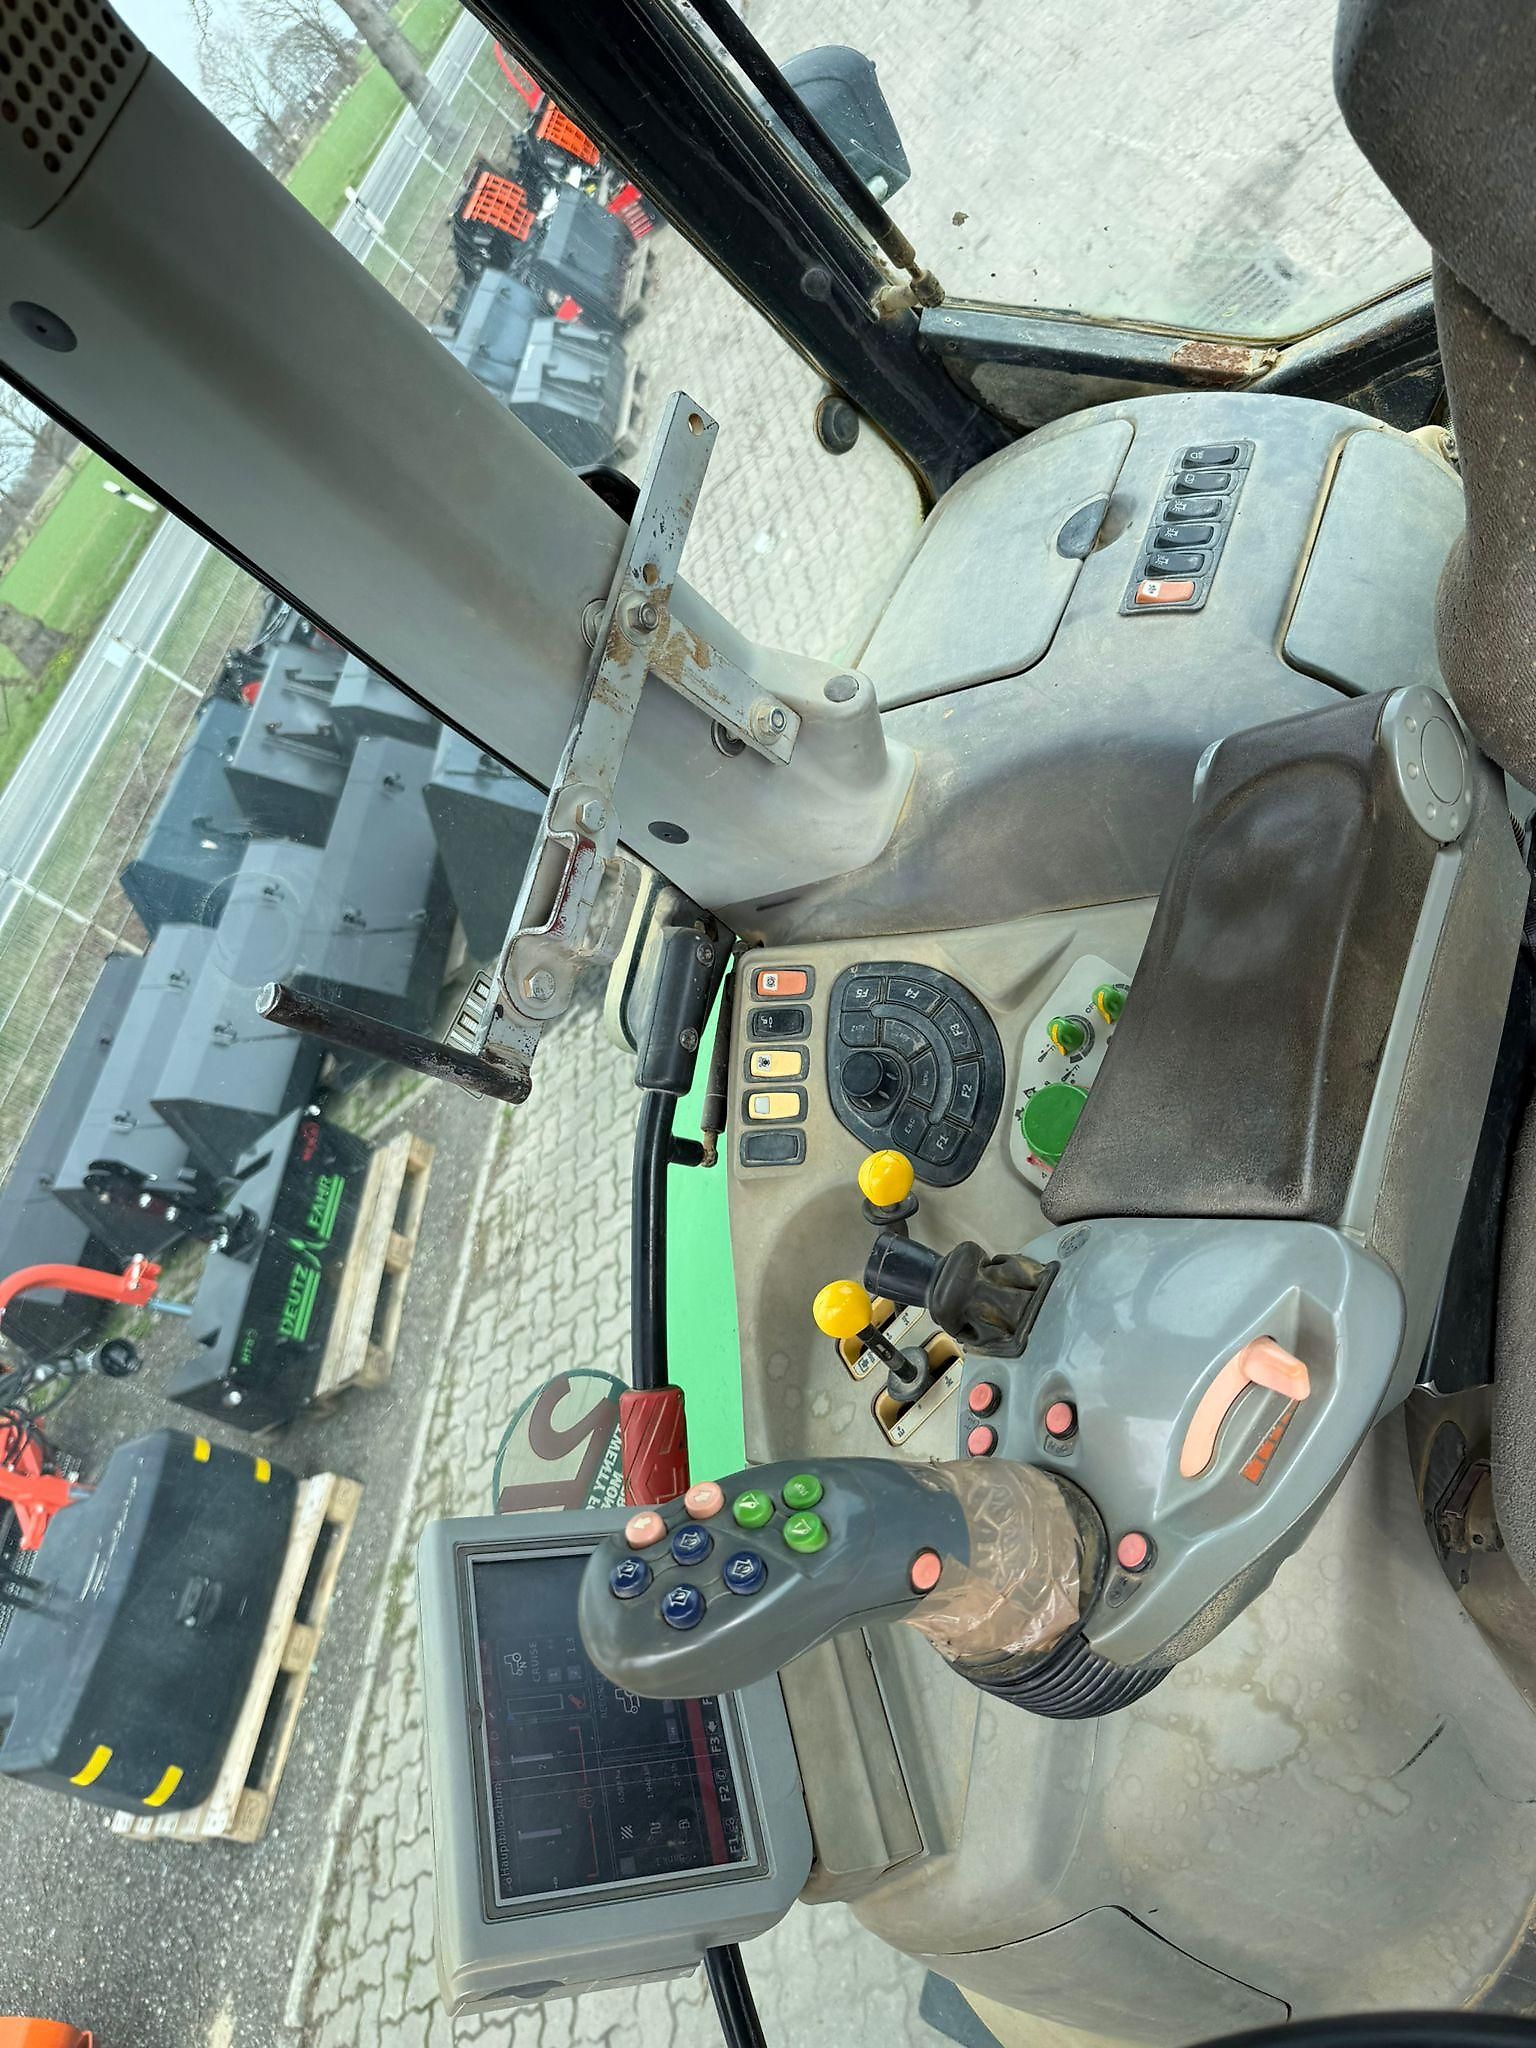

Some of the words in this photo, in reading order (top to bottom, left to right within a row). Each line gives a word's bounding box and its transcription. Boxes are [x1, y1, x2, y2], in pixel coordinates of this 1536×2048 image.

[855, 987, 869, 998] F5
[905, 987, 920, 999] F4
[950, 1023, 963, 1037] F3
[961, 1083, 973, 1098] F2
[936, 1134, 949, 1150] F1
[279, 1263, 308, 1335] DEUTZ
[307, 1174, 332, 1228] FAHR
[528, 1640, 540, 1682] CRUISE
[710, 1736, 721, 1753] F3
[719, 1785, 731, 1802] F2
[728, 1836, 741, 1853] F1
